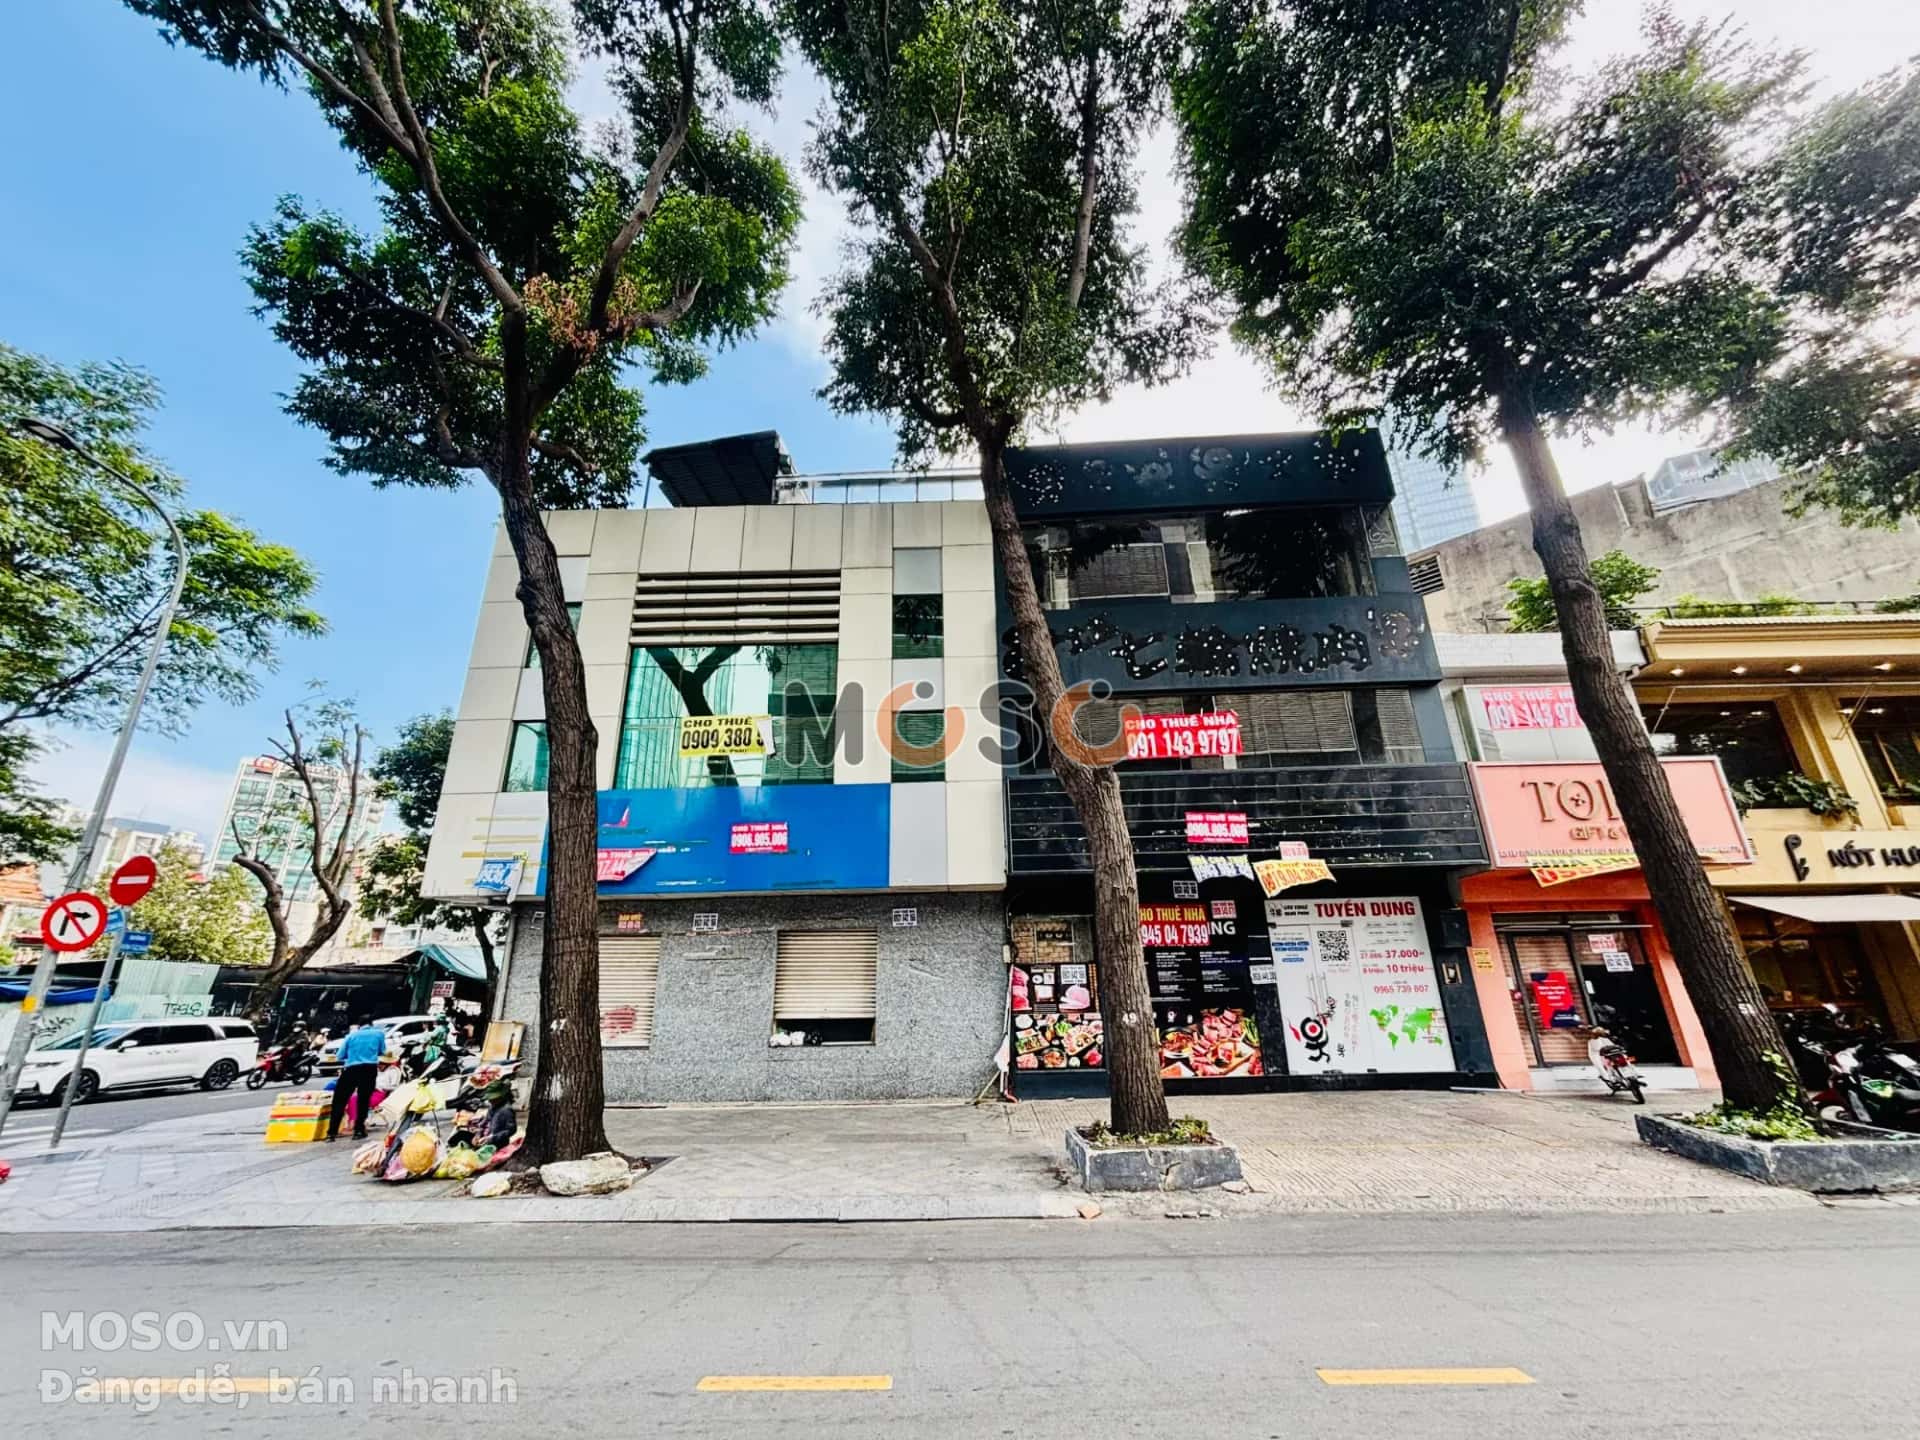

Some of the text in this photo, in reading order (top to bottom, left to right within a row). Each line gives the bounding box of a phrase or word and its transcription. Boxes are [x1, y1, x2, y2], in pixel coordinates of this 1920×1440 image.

[683, 717, 753, 728] CHO THUÊ
[1125, 714, 1236, 729] CHO THUÊ NHÀ
[682, 729, 720, 750] 0909
[723, 727, 753, 747] 380
[1127, 728, 1239, 757] 091 143 9797
[1827, 840, 1876, 869] NỐT
[1140, 908, 1153, 921] HO
[1156, 905, 1181, 921] THUÊ
[1184, 905, 1206, 921] NHÀ
[1164, 924, 1178, 944] 04
[1181, 924, 1208, 944] 7939
